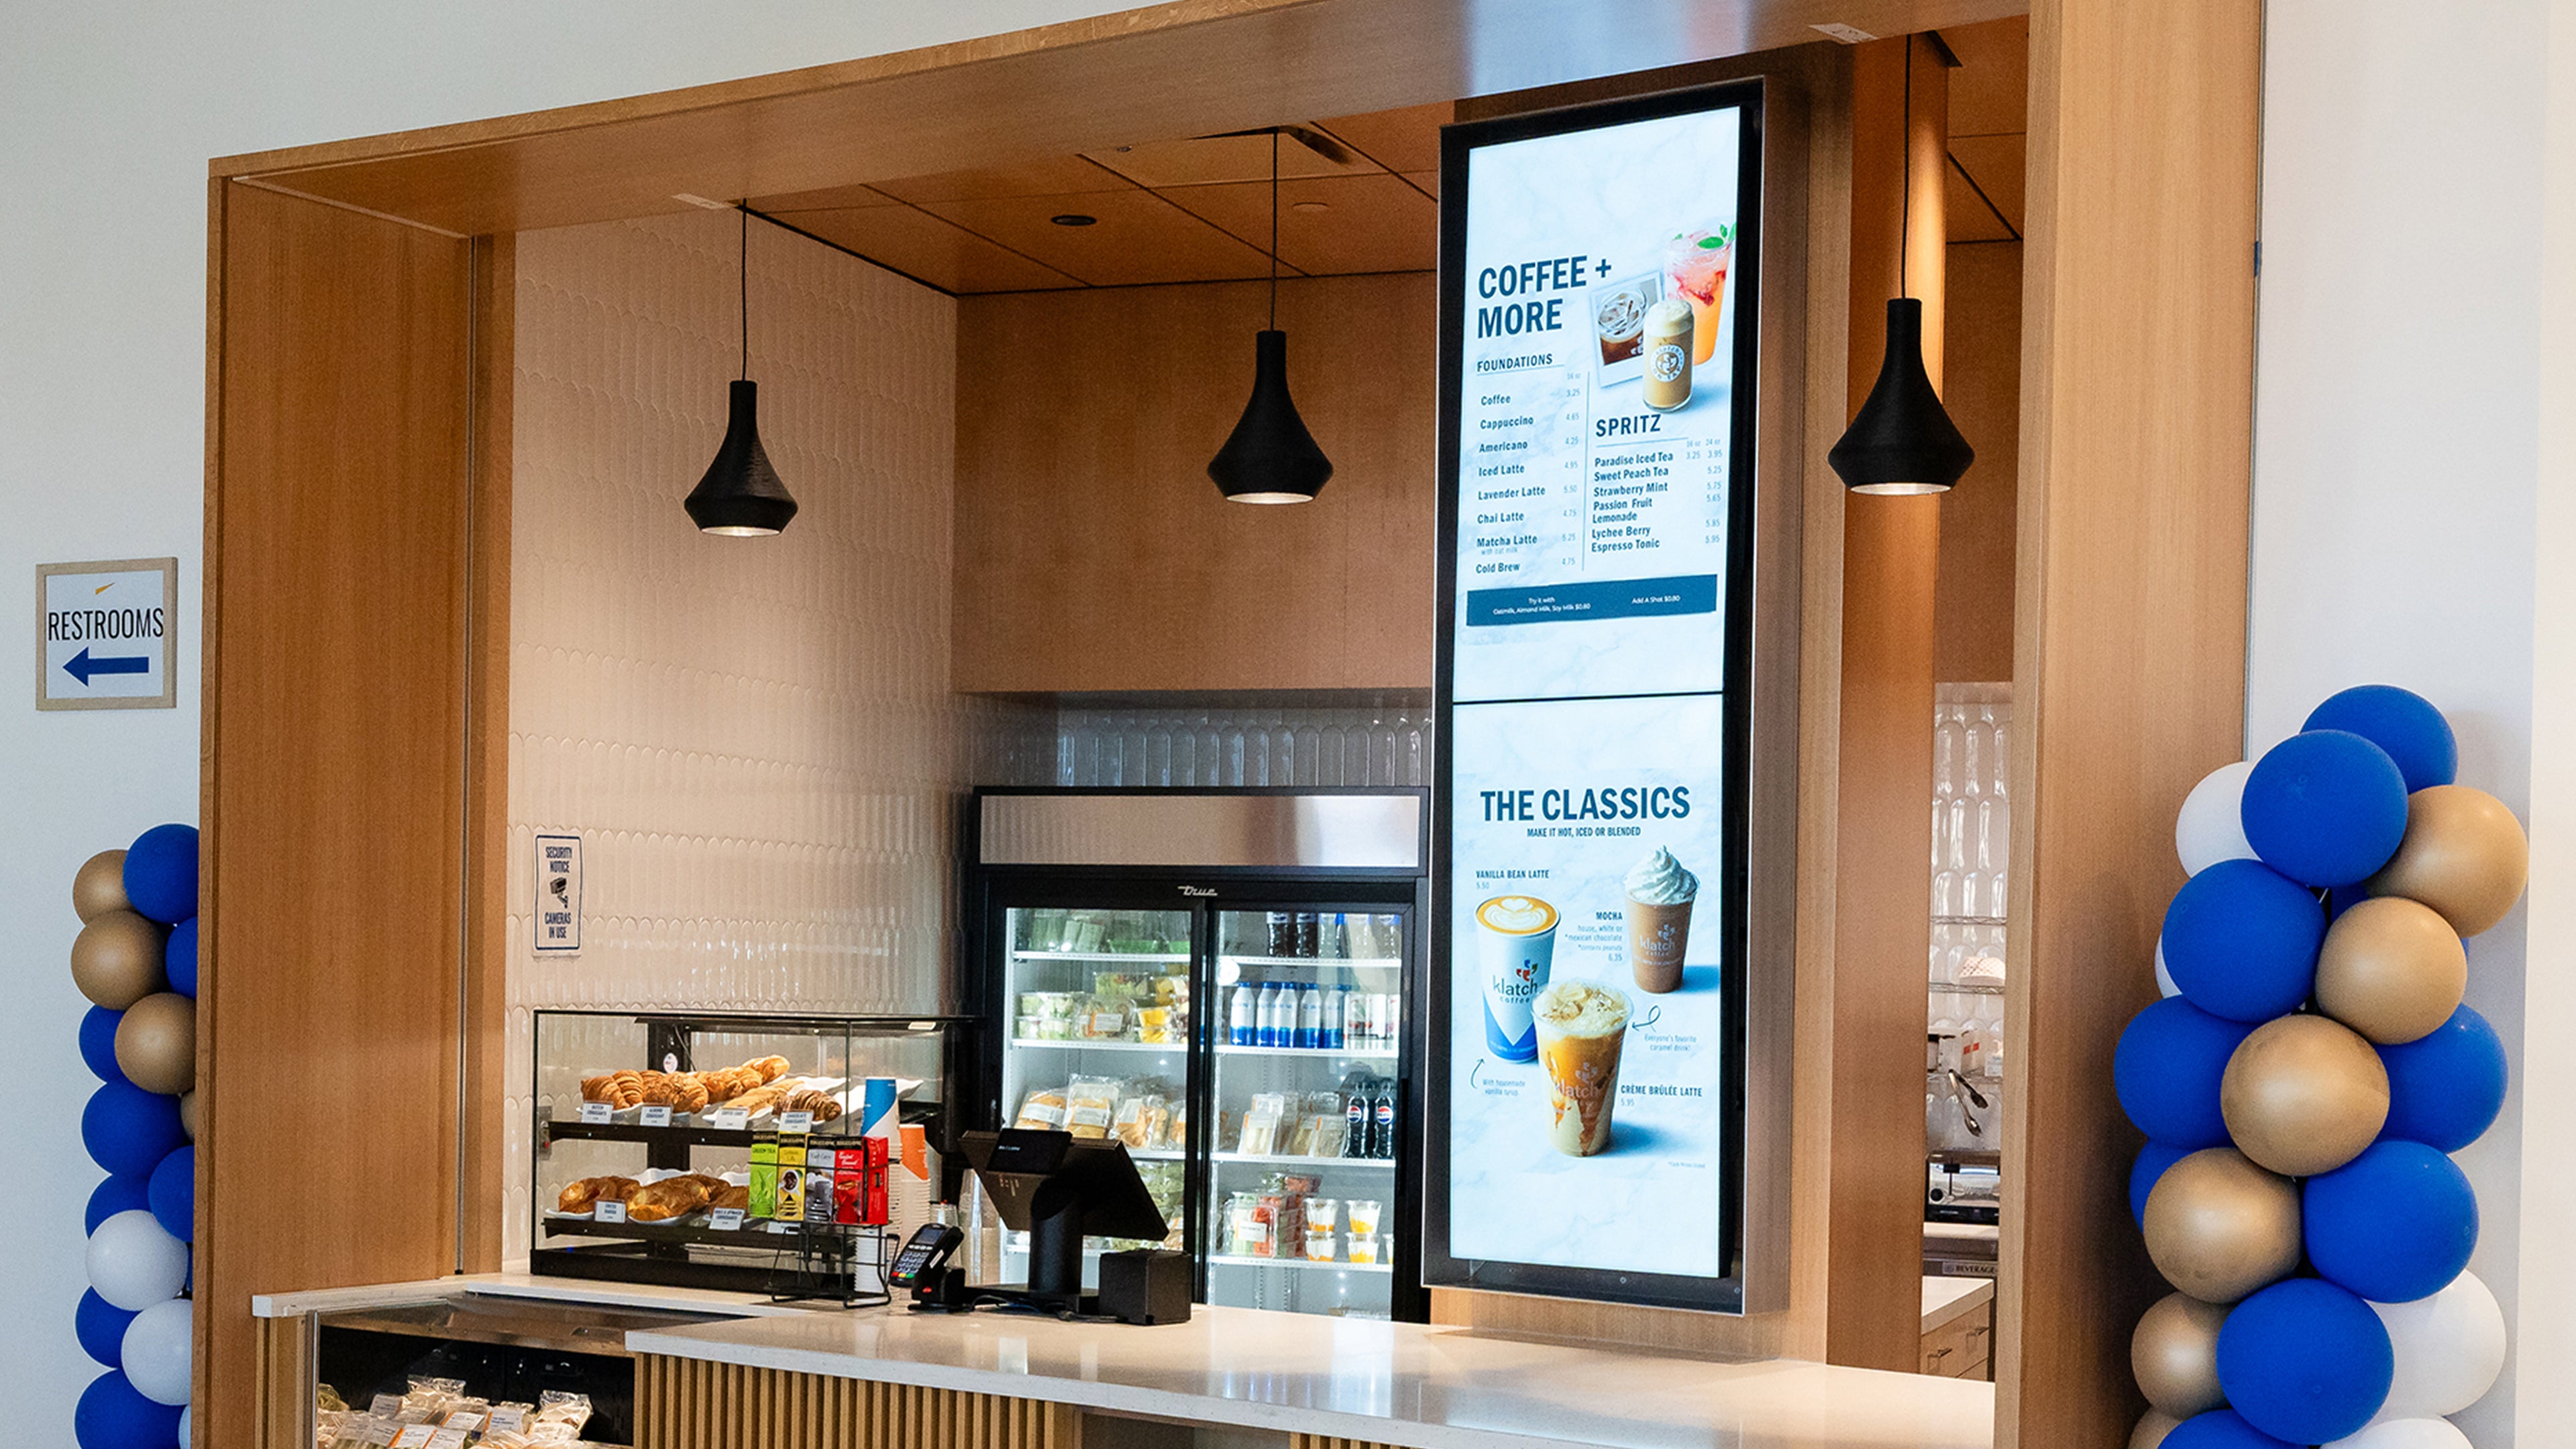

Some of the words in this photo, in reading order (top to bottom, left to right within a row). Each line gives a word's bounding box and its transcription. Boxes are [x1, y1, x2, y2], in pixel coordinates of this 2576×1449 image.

[1479, 255, 1588, 299] COFFEE
[1595, 259, 1612, 278] +
[1477, 299, 1564, 339] MORE
[1477, 354, 1553, 372] FOUNDATIONS
[1566, 388, 1580, 397] 3.25
[1481, 394, 1511, 406] Coffee
[1480, 416, 1534, 430] Cappuccino
[1596, 414, 1661, 437] SPRITZ
[1479, 441, 1527, 453] Americano
[1595, 455, 1633, 467] Paradise
[1636, 453, 1656, 464] Iced
[1658, 451, 1674, 462] Tea
[1479, 466, 1499, 476] Iced
[1501, 464, 1525, 475] Latte
[1594, 471, 1621, 482] Sweet
[1623, 468, 1651, 479] Peach
[1653, 466, 1669, 477] Tea
[1478, 489, 1519, 500] Lavender
[1521, 487, 1546, 497] Latte
[1594, 486, 1644, 497] Strawberry
[1646, 482, 1668, 493] Mint
[1593, 500, 1628, 511] Passion
[1631, 497, 1652, 508] Fruit
[1477, 513, 1498, 524] Chai
[1500, 512, 1524, 523] Latte
[1593, 512, 1638, 524] Lemonade
[1592, 529, 1623, 540] Lychee
[1626, 526, 1651, 537] Berry
[1477, 536, 1511, 547] Matcha
[1513, 535, 1538, 545] Latte
[1591, 542, 1633, 553] Espresso
[1635, 538, 1660, 549] Tonic
[1476, 564, 1496, 574] Cold
[1497, 562, 1521, 572] Brew
[48, 608, 164, 641] RESTROOMS
[1480, 790, 1535, 821] THE
[1542, 786, 1690, 821] CLASSICS
[1527, 828, 1547, 837] MAKE
[1548, 828, 1556, 837] IT
[1558, 827, 1574, 838] HOT,
[1576, 827, 1593, 837] ICED
[1595, 826, 1606, 837] OR
[1607, 826, 1642, 837] BLENDED
[545, 847, 572, 859] SECURITY
[550, 861, 570, 873] NOTICE
[1475, 870, 1505, 879] VANILLA
[1507, 870, 1526, 879] BEAN
[1528, 869, 1550, 879] LATTE
[1177, 885, 1218, 896] True
[545, 912, 572, 924] CAMERAS
[1595, 911, 1623, 920] MOCHA
[549, 927, 555, 938] IN
[556, 926, 567, 938] USE
[1640, 935, 1676, 951] klatch
[1493, 975, 1538, 996] klatch
[1621, 1083, 1646, 1095] CRÈME
[1680, 1087, 1703, 1097] LATTE
